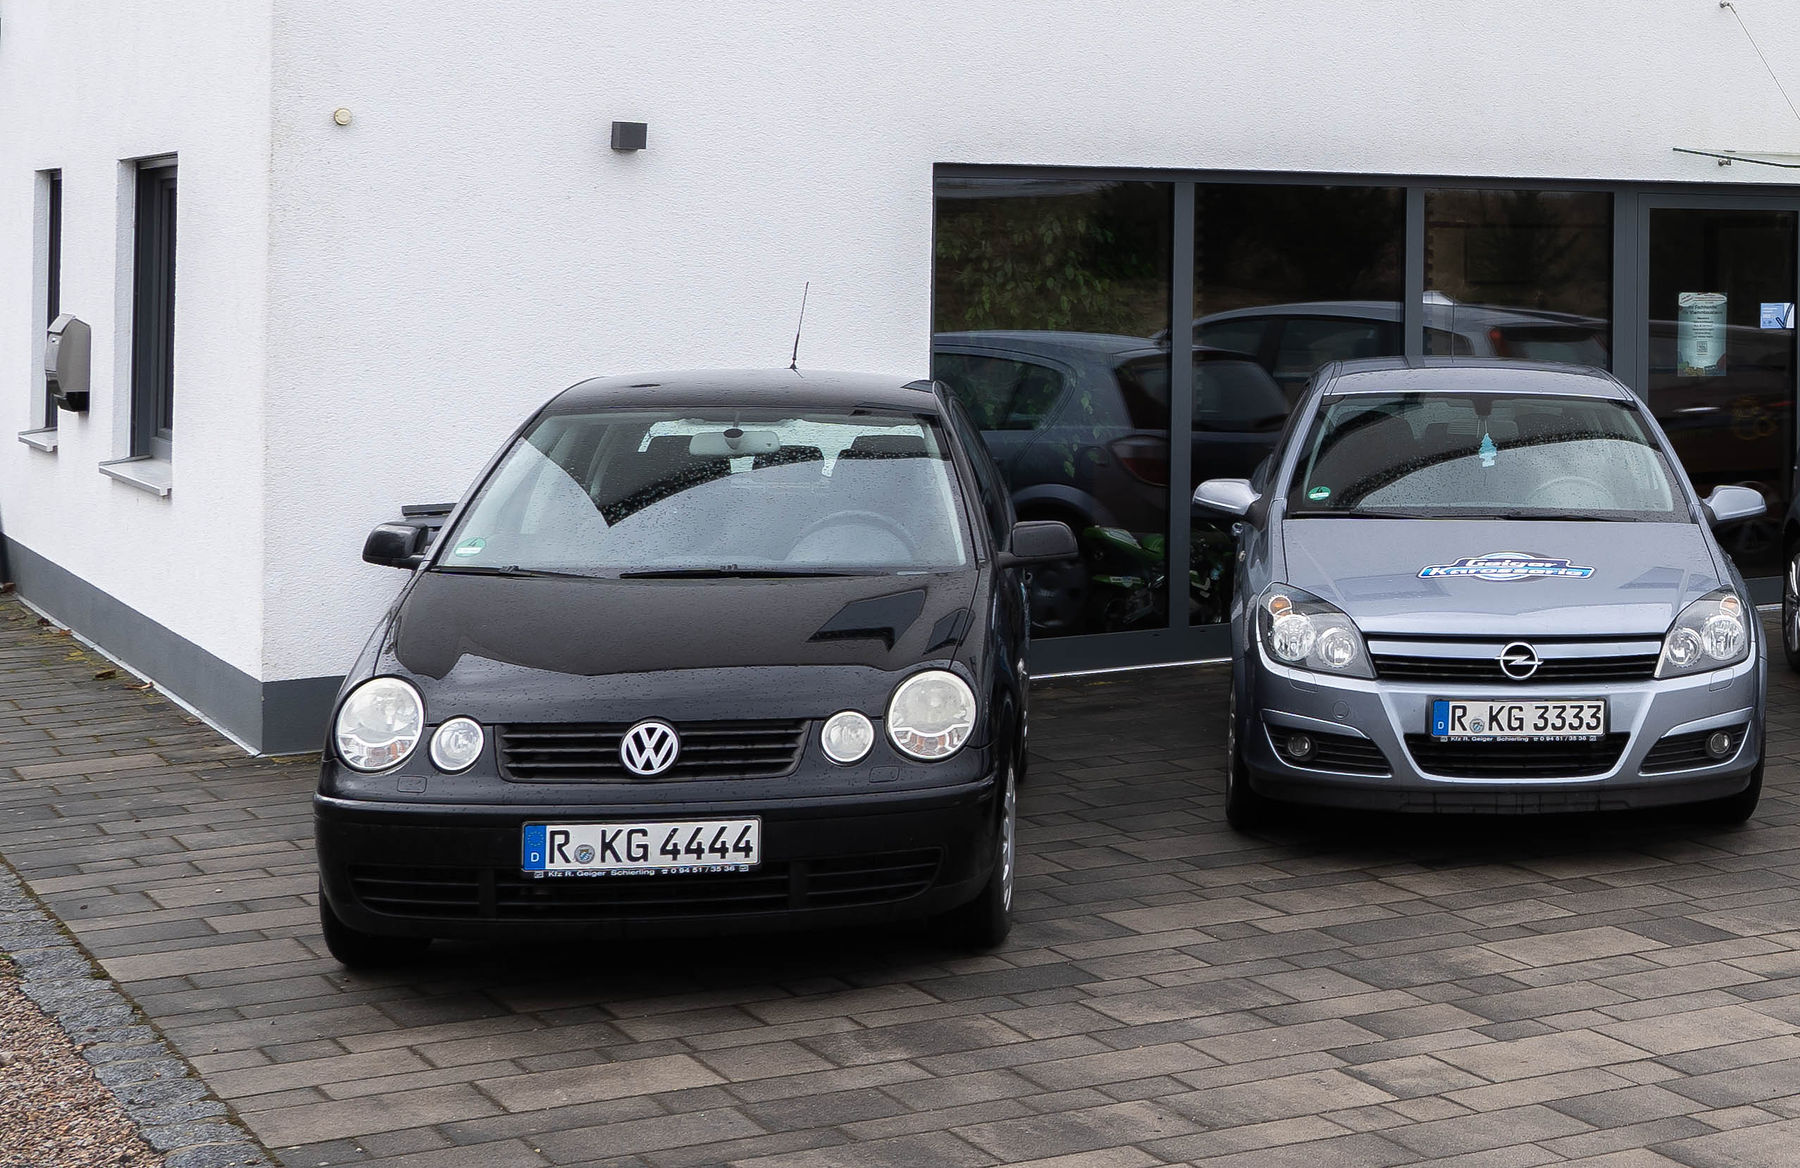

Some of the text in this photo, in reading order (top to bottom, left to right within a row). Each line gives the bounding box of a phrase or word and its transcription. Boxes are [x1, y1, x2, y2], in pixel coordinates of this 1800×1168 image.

[1428, 567, 1583, 576] Karosserie
[1451, 705, 1602, 732] R KG 3333
[548, 825, 753, 865] R KG 4444
[530, 852, 540, 863] D
[576, 870, 607, 878] Geiger
[610, 868, 655, 876] Schierling
